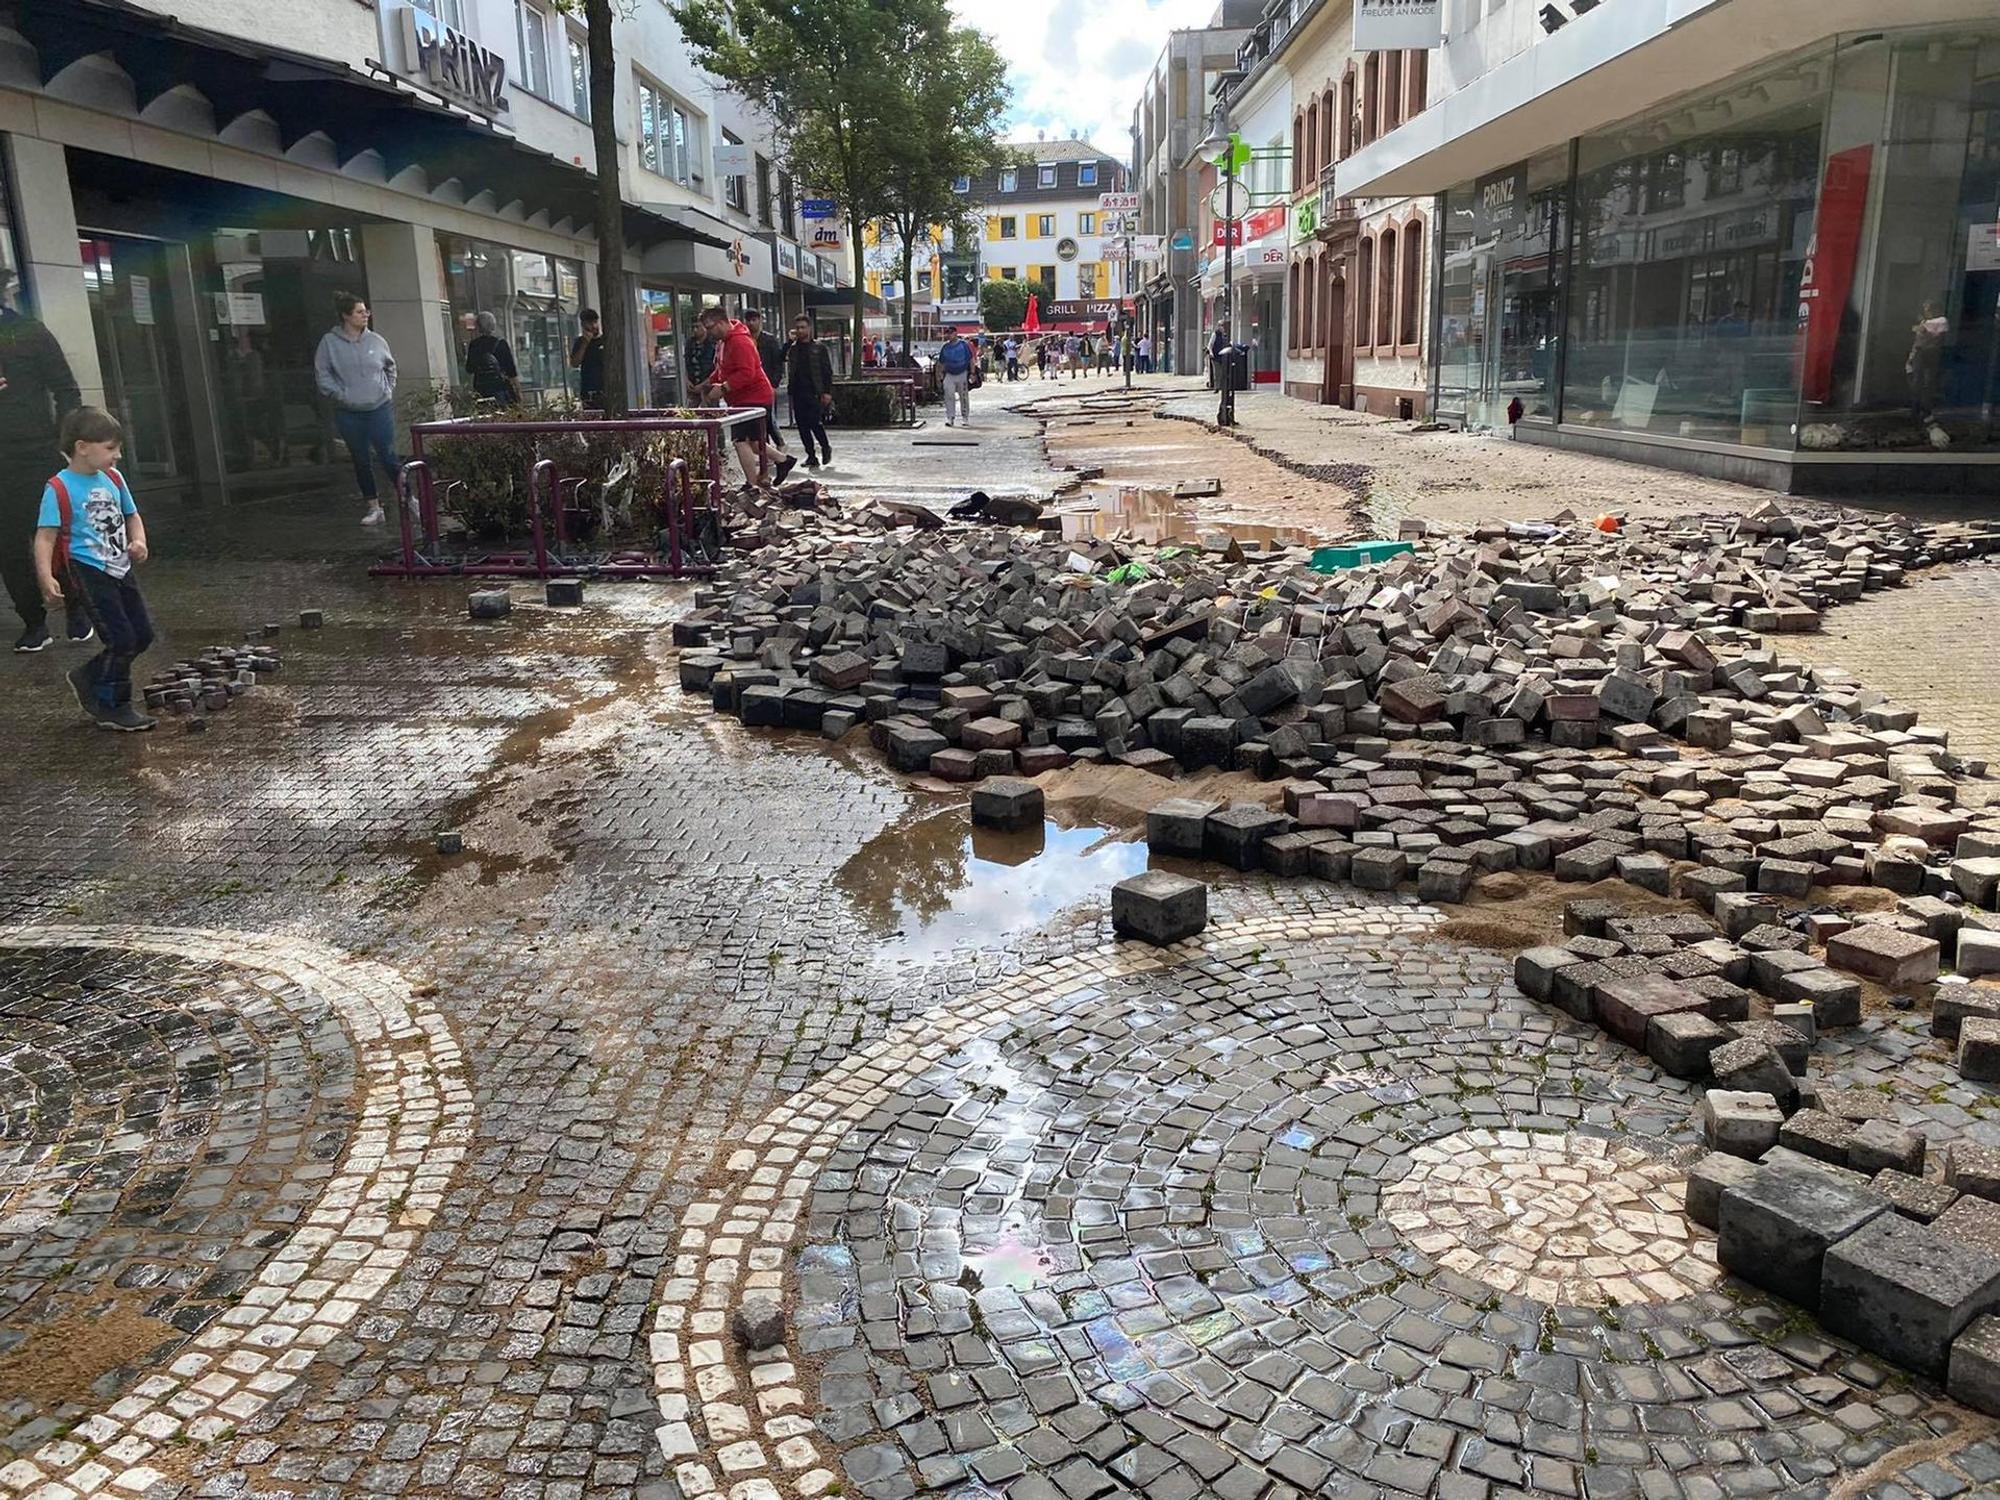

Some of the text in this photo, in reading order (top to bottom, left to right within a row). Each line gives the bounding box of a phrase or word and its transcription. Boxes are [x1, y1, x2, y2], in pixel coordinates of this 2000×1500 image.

[1411, 6, 1435, 15] MODE
[814, 227, 837, 241] dm
[1263, 252, 1284, 263] DER
[1046, 302, 1117, 315] GRILL PIZZA
